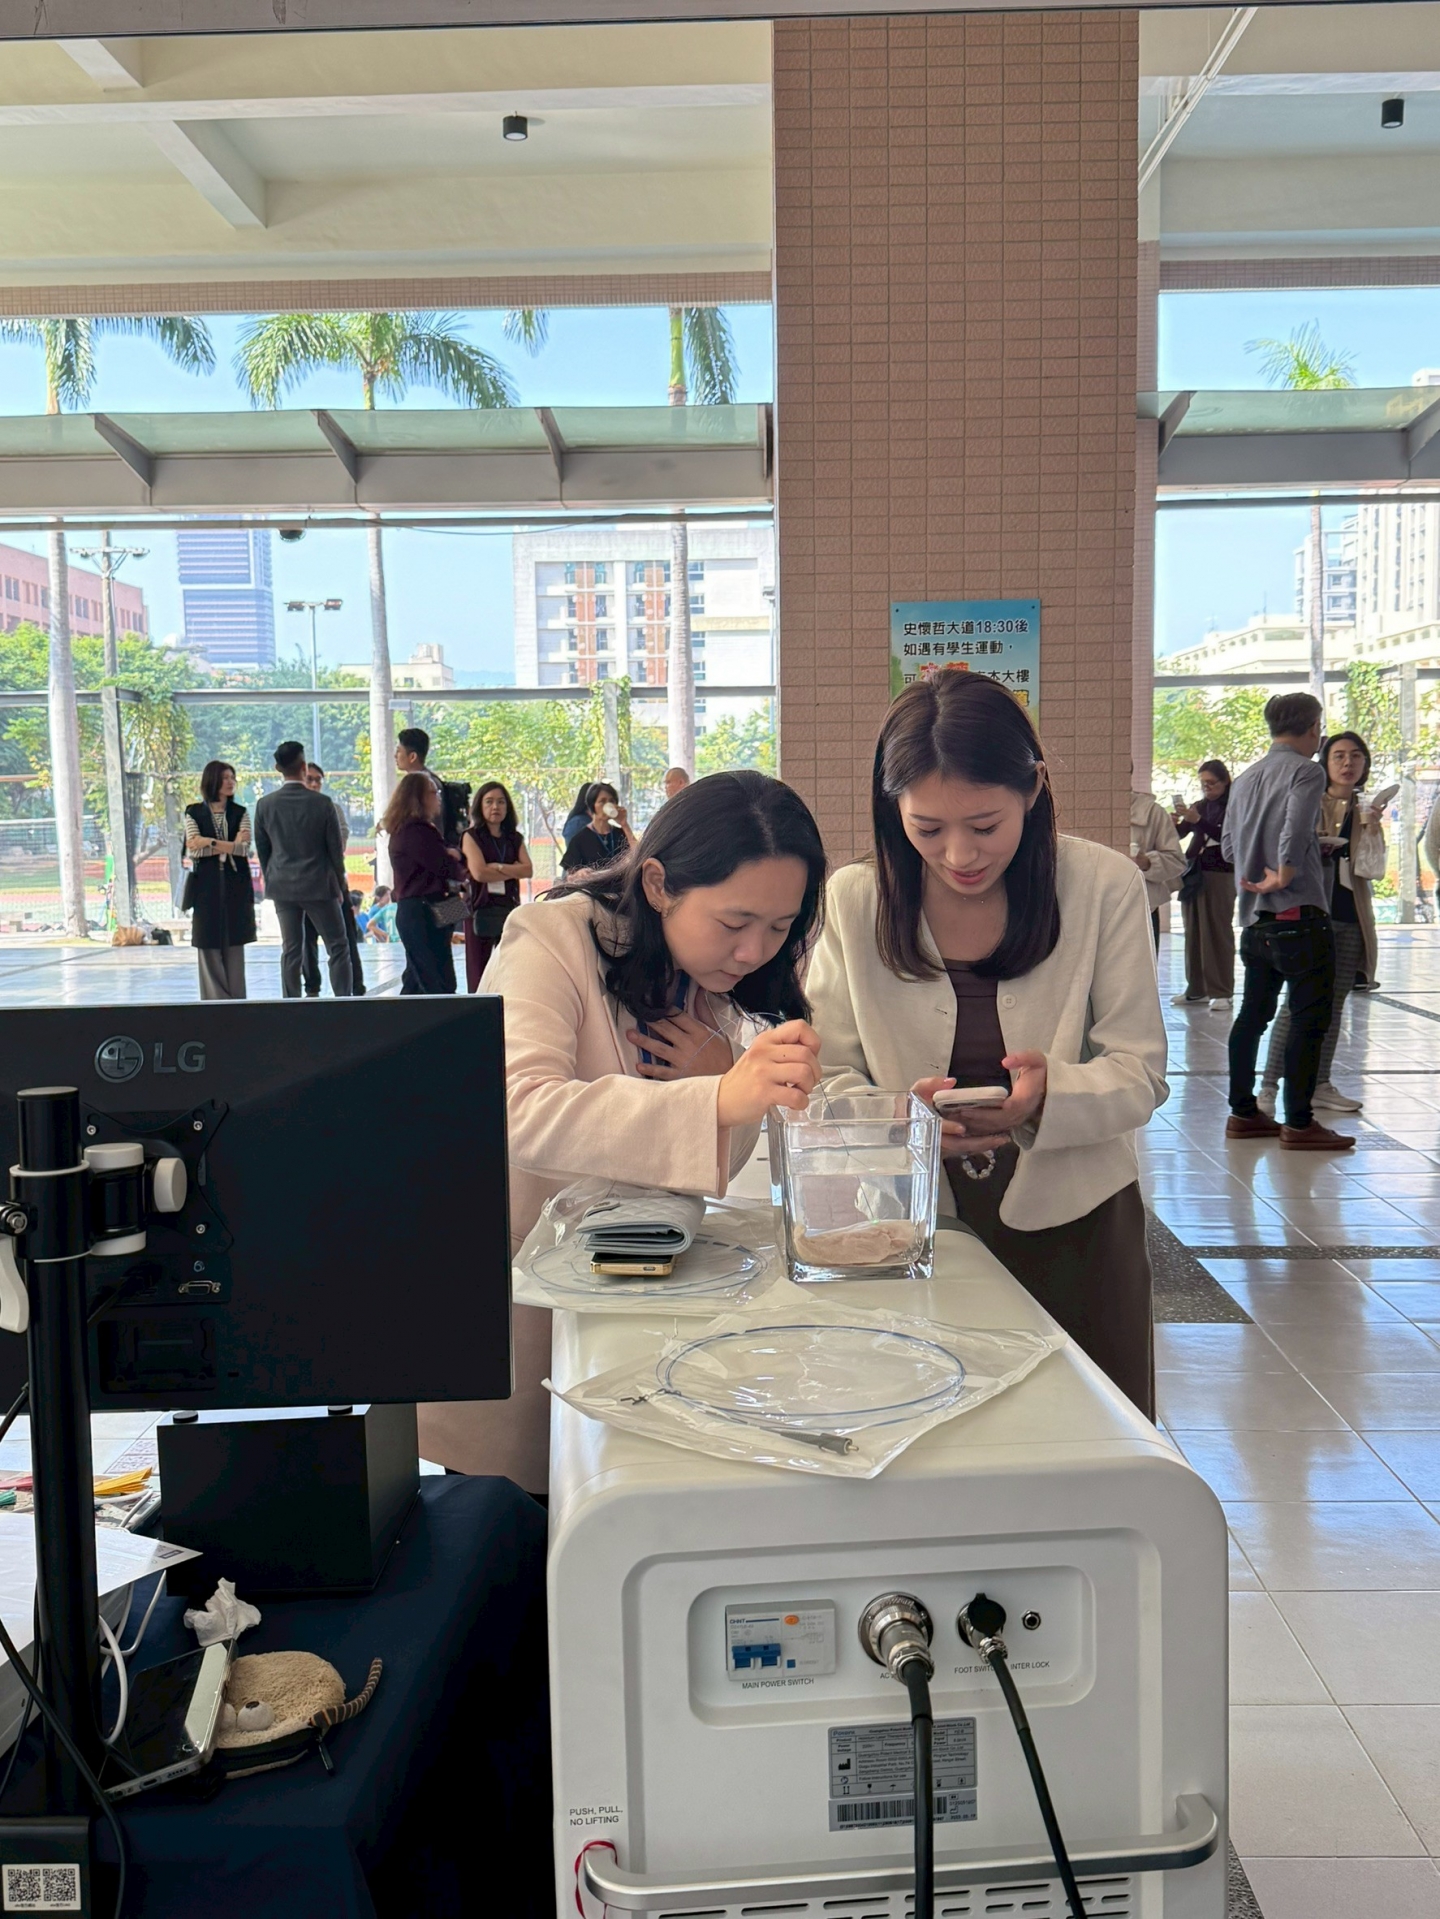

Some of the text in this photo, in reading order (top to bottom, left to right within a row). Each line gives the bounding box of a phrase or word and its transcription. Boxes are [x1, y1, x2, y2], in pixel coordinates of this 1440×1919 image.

[903, 619, 1029, 636] 史懷哲大道18:30後
[153, 1040, 206, 1074] LG
[954, 1666, 973, 1674] FOOT
[1010, 1661, 1050, 1670] INTER LOCK
[742, 1678, 814, 1690] MAIN POWER SWITCH
[569, 1805, 624, 1816] PUSH, PULL,
[569, 1815, 620, 1826] NO LIFTING
